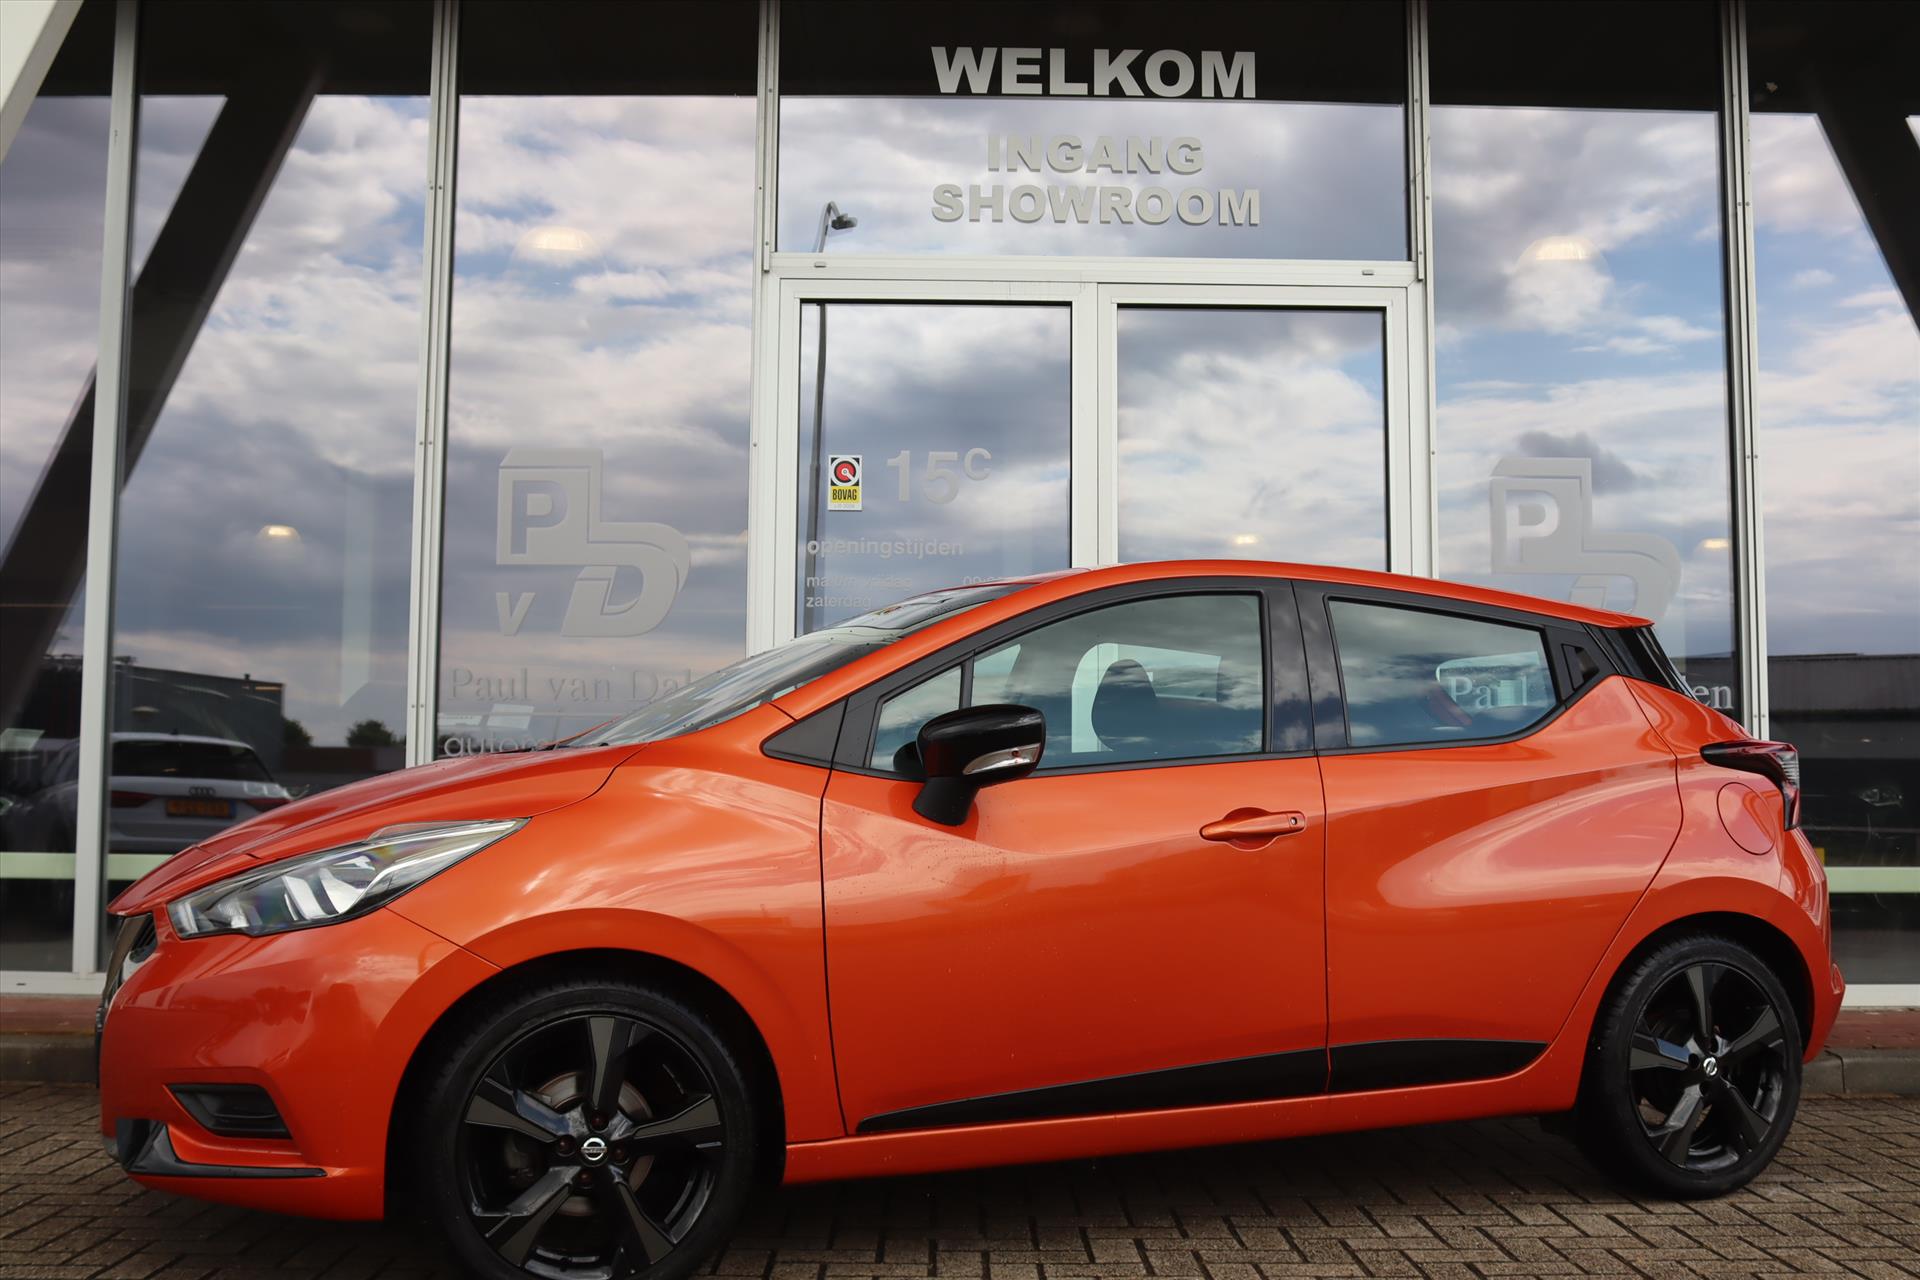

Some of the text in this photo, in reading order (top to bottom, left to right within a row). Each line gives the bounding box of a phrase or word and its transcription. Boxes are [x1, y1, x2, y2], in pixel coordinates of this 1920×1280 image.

[931, 46, 1257, 98] WELKOM
[987, 135, 1204, 175] INGANG
[931, 184, 1260, 226] SHOWROOM
[832, 488, 857, 501] BOVAG
[807, 537, 964, 560] openingstijden
[449, 668, 530, 701] Paul
[547, 676, 613, 702] van
